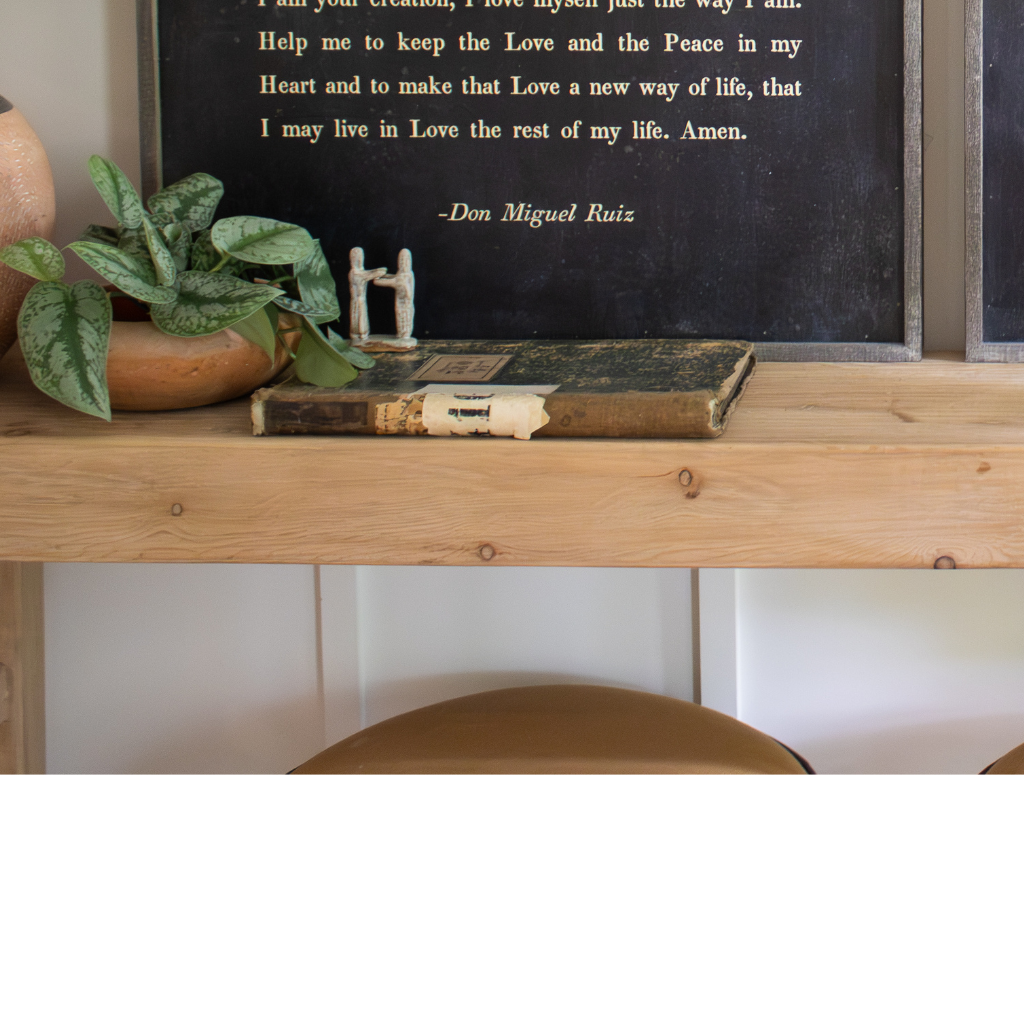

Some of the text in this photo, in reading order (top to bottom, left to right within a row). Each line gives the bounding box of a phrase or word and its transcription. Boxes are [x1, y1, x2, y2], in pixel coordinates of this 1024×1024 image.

[258, 31, 803, 60] Help me to keep the Love and the Peace in my
[260, 118, 748, 146] I may live in Love the rest of my life. Amen.
[438, 202, 635, 229] -Don Miguel Ruiz
